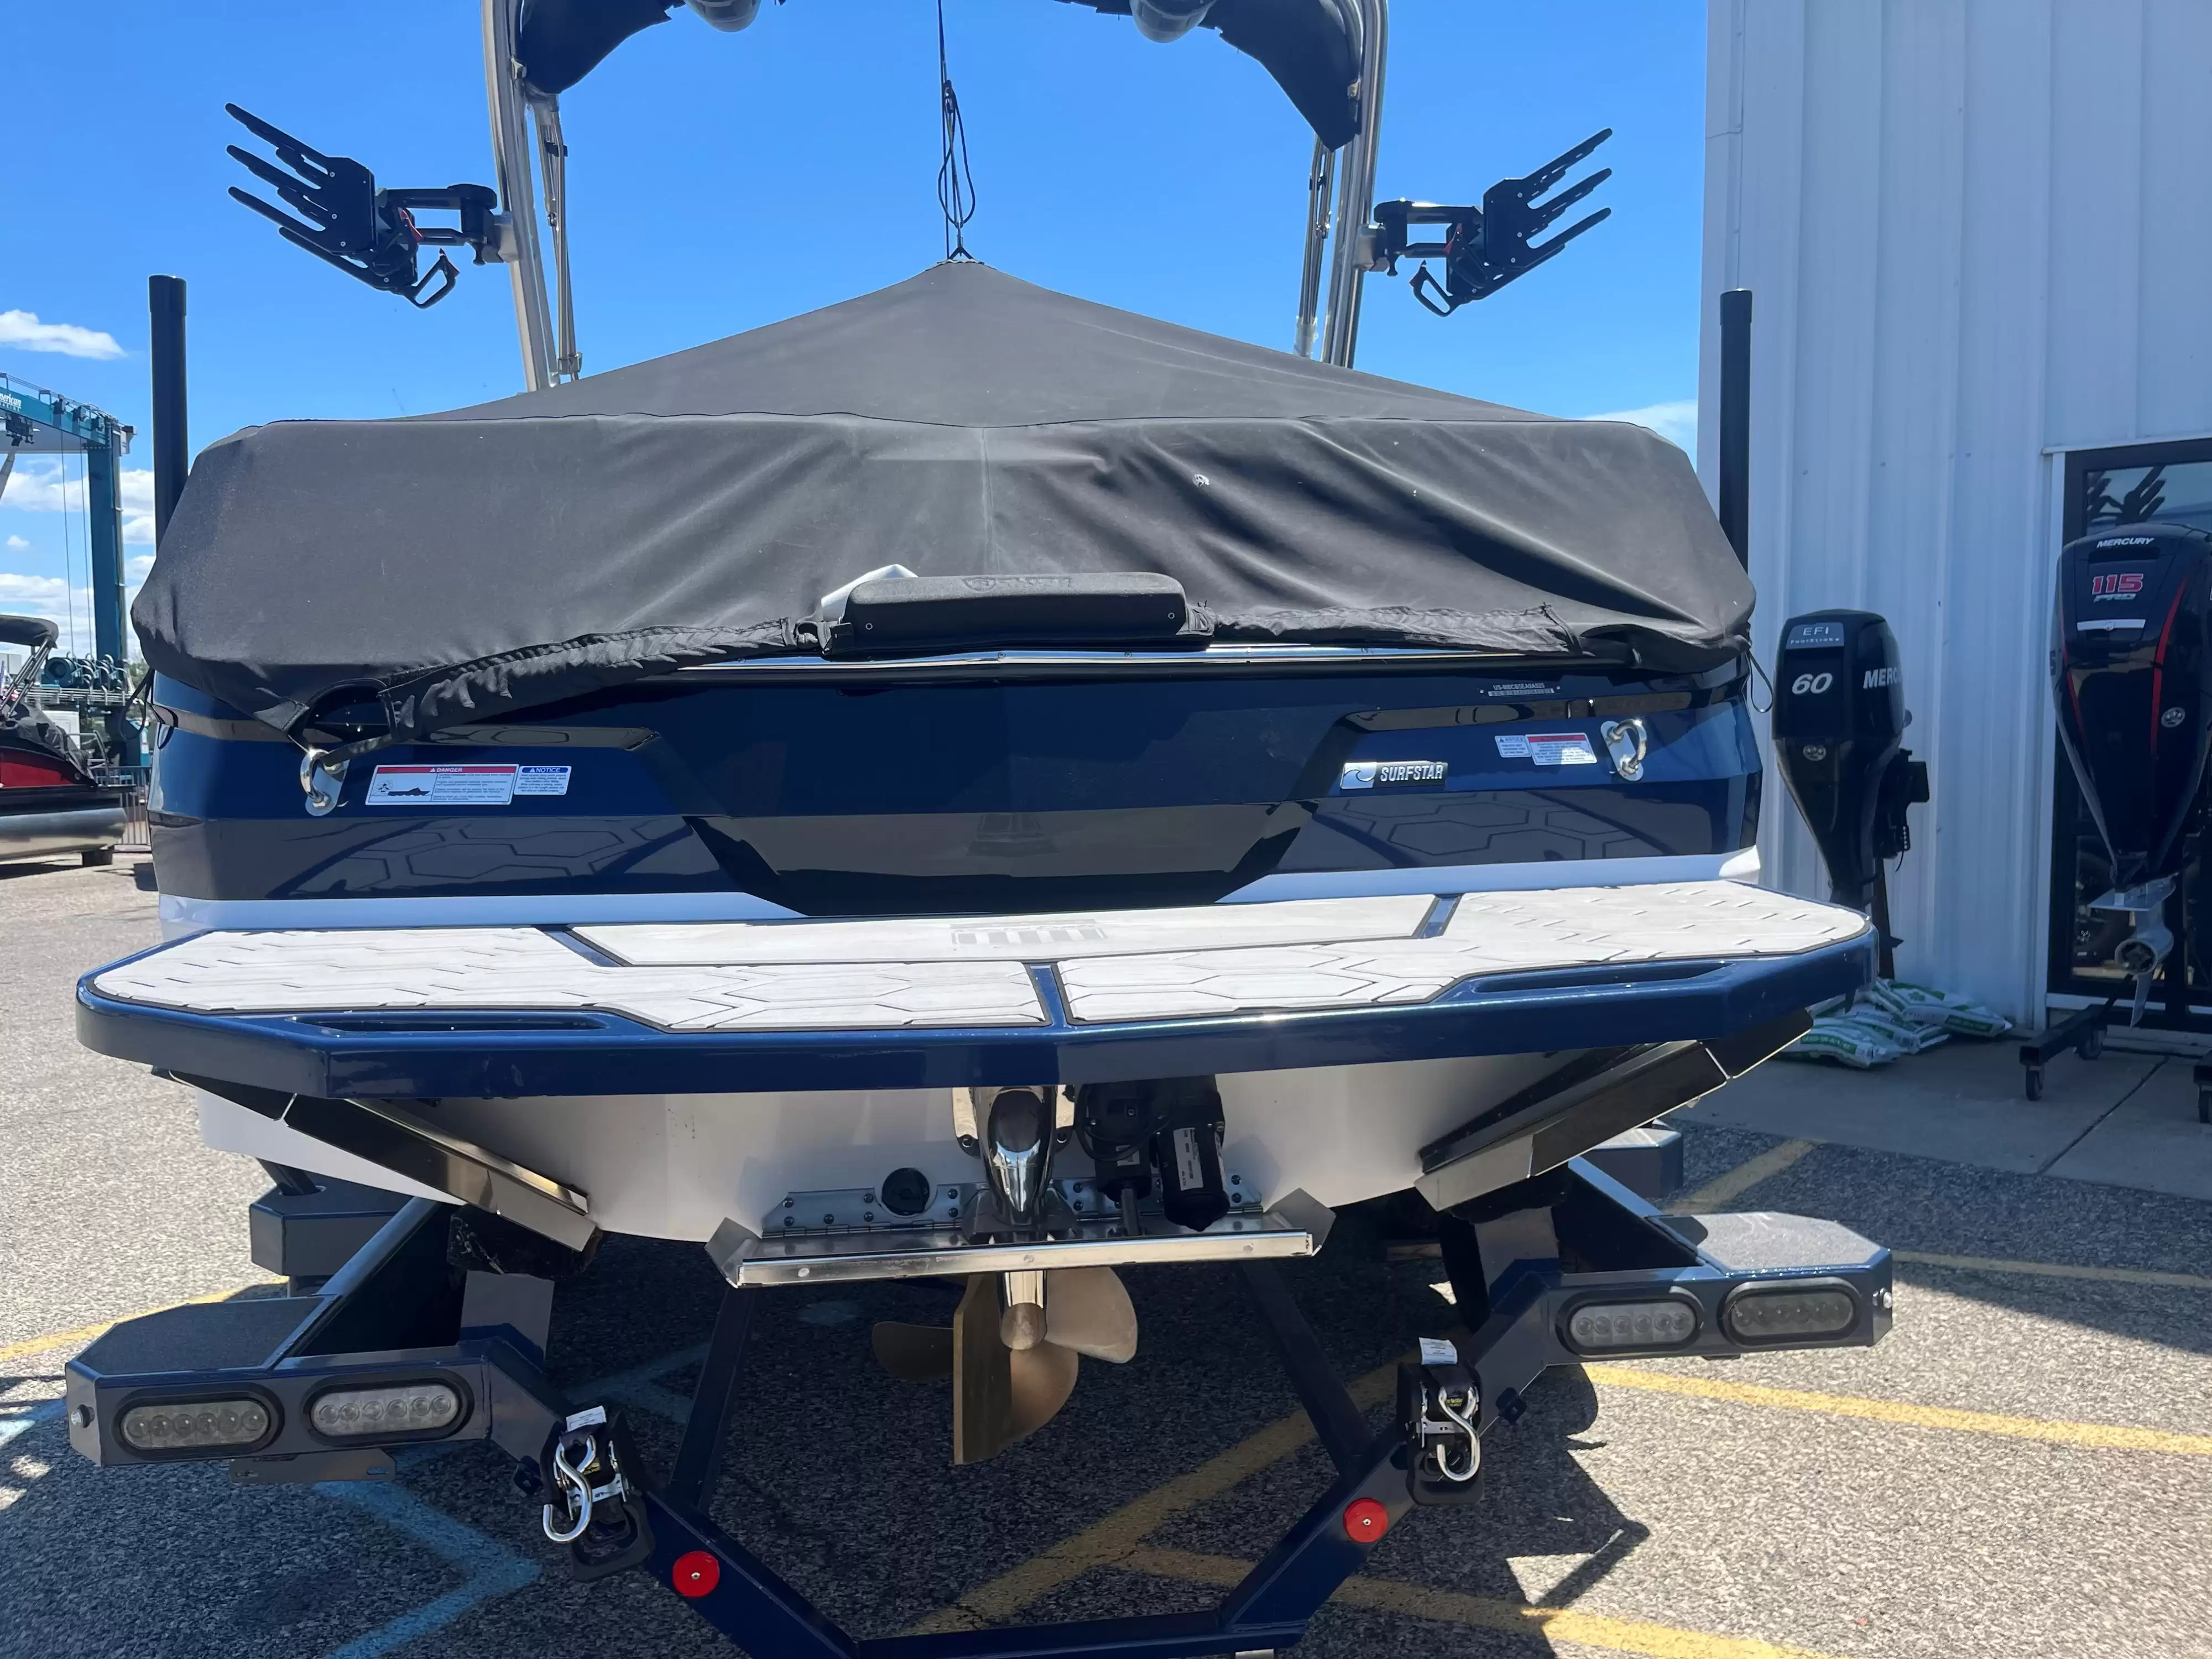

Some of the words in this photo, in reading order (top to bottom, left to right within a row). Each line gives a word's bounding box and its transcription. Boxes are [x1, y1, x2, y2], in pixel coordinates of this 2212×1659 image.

[2096, 538, 2154, 548] MERCURY
[2092, 573, 2143, 595] 115
[1803, 627, 1829, 636] EFI
[1792, 672, 1833, 695] 60
[1863, 667, 1901, 689] MERC
[1380, 764, 1444, 782] SURFSTAR
